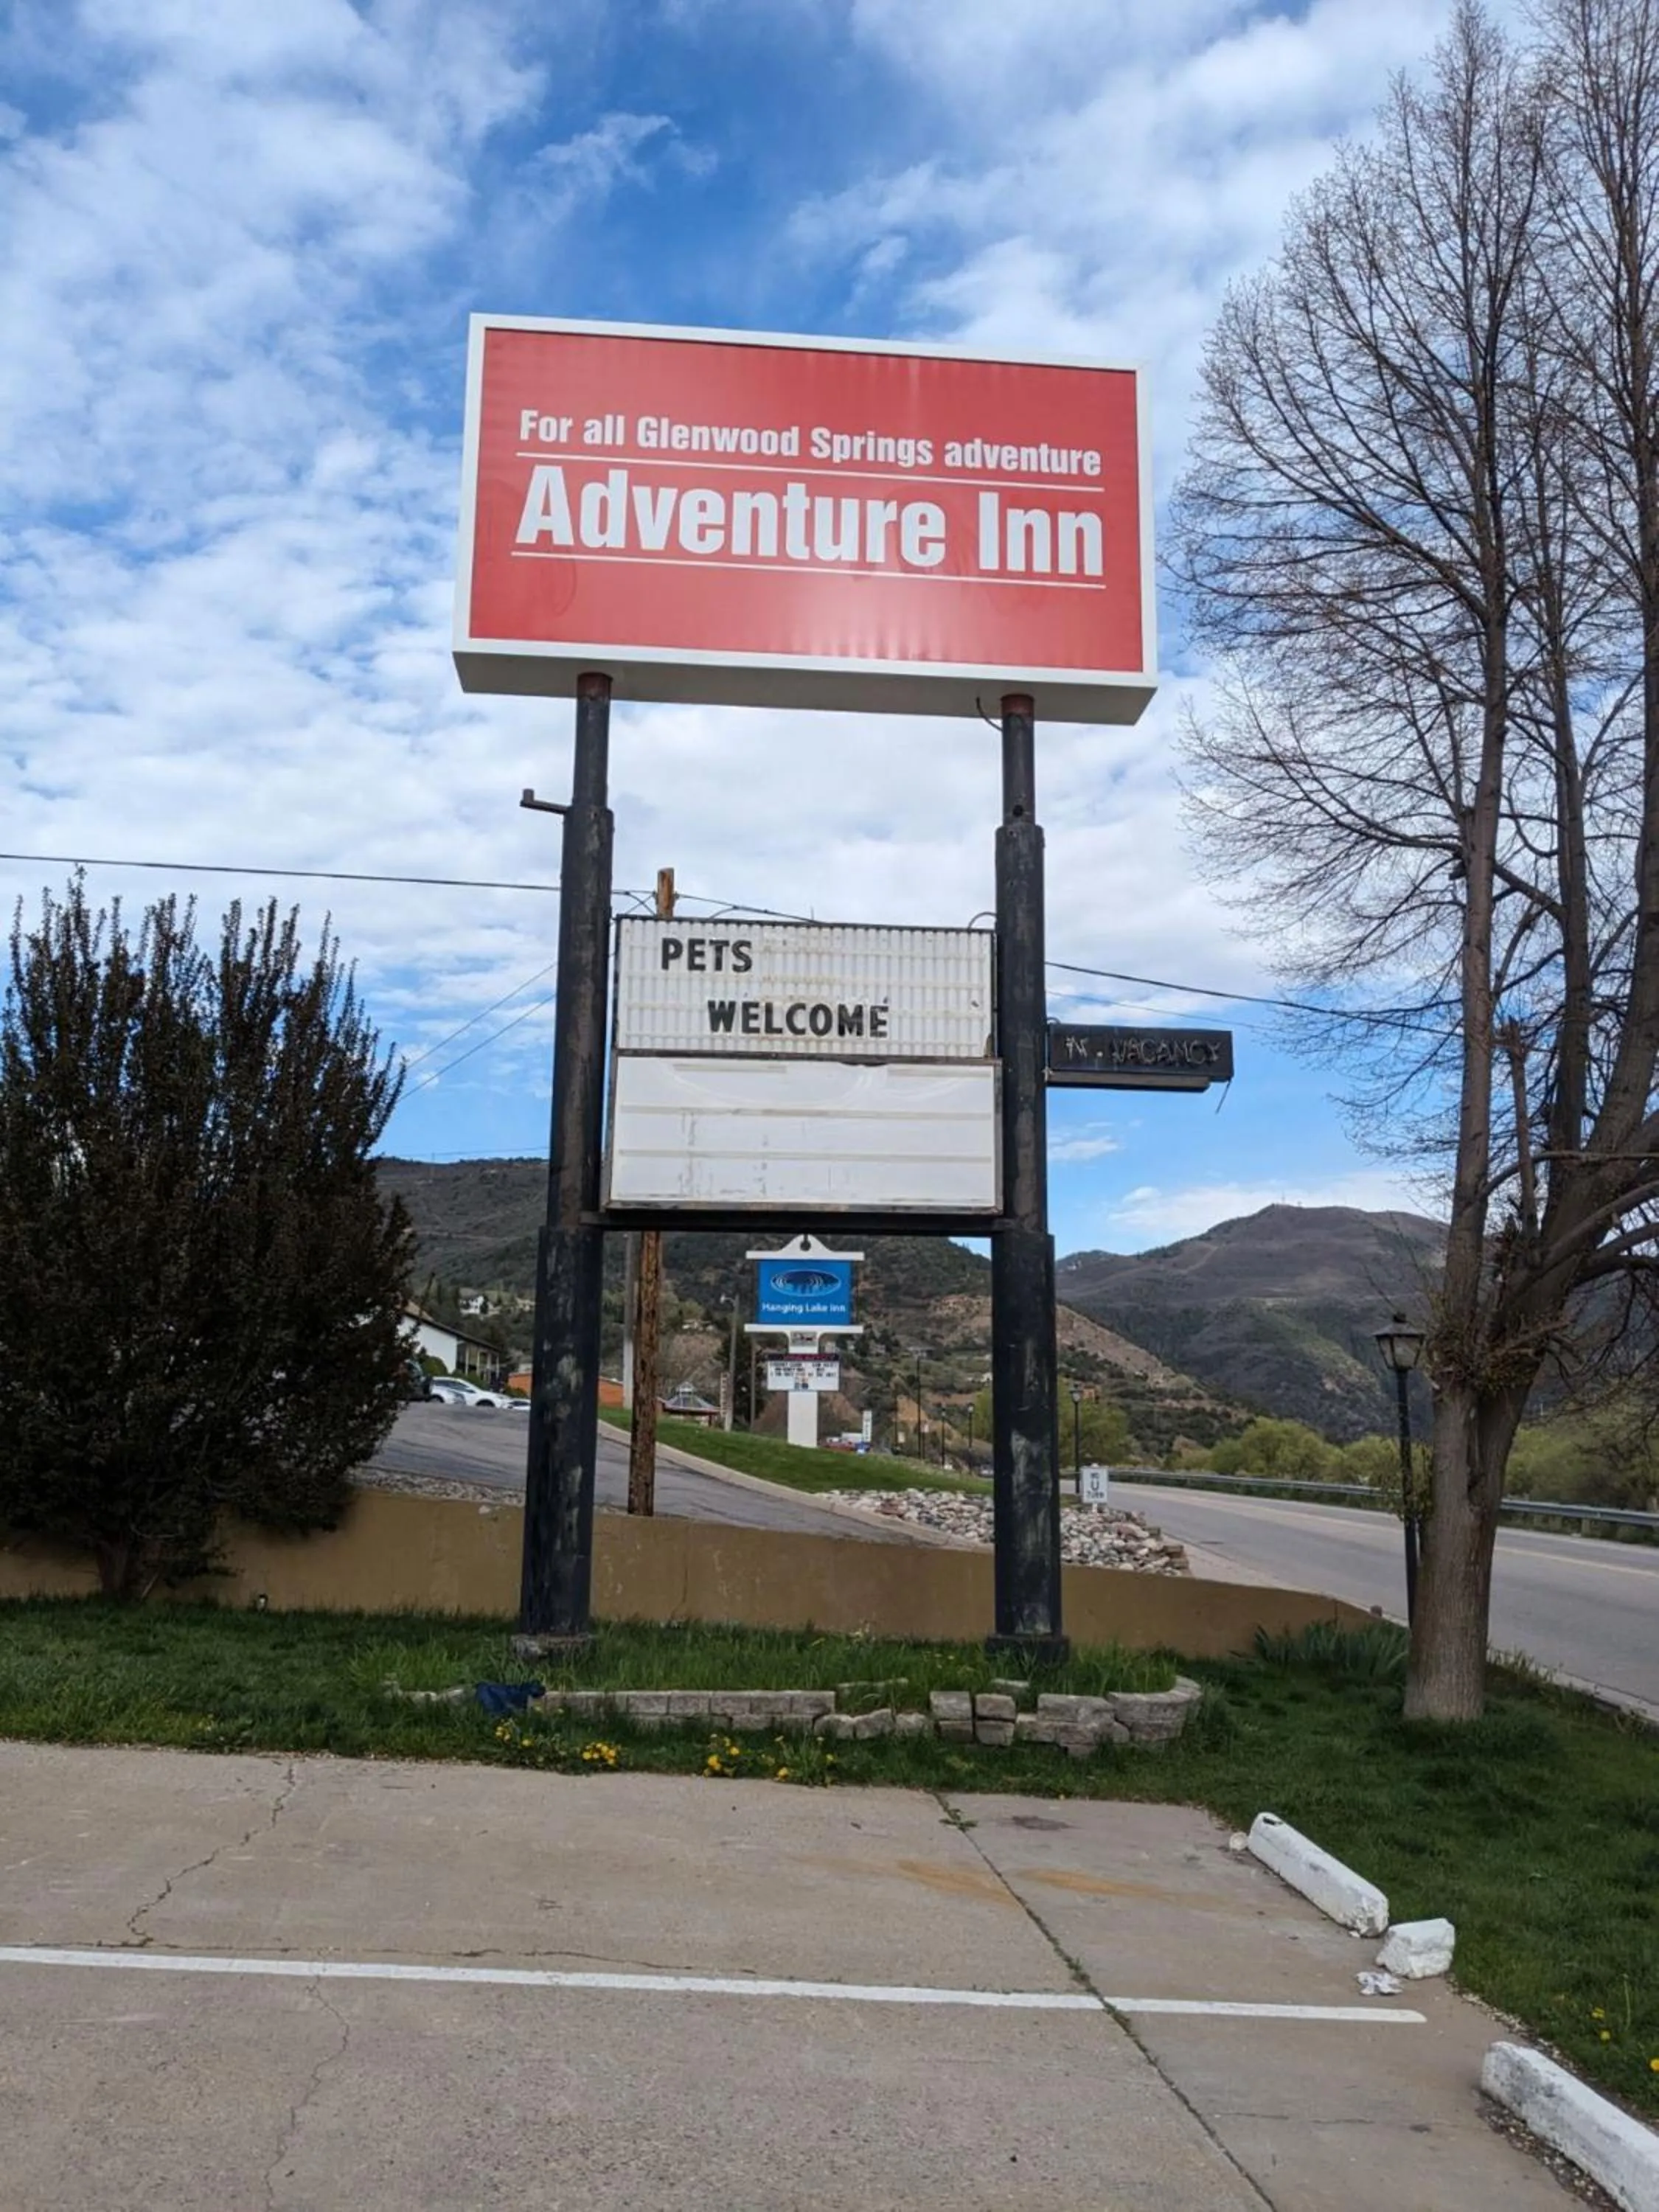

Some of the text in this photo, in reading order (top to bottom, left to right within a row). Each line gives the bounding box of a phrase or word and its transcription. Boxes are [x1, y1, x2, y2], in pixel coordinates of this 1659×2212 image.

[519, 408, 1101, 476] For all Glenwood Springs adventure
[515, 463, 1104, 577] Adventure Inn
[661, 937, 754, 973] PETS
[708, 999, 890, 1038] WELCOME
[1112, 1036, 1221, 1065] VACANCY
[762, 1302, 846, 1315] Hanging Lake Inn
